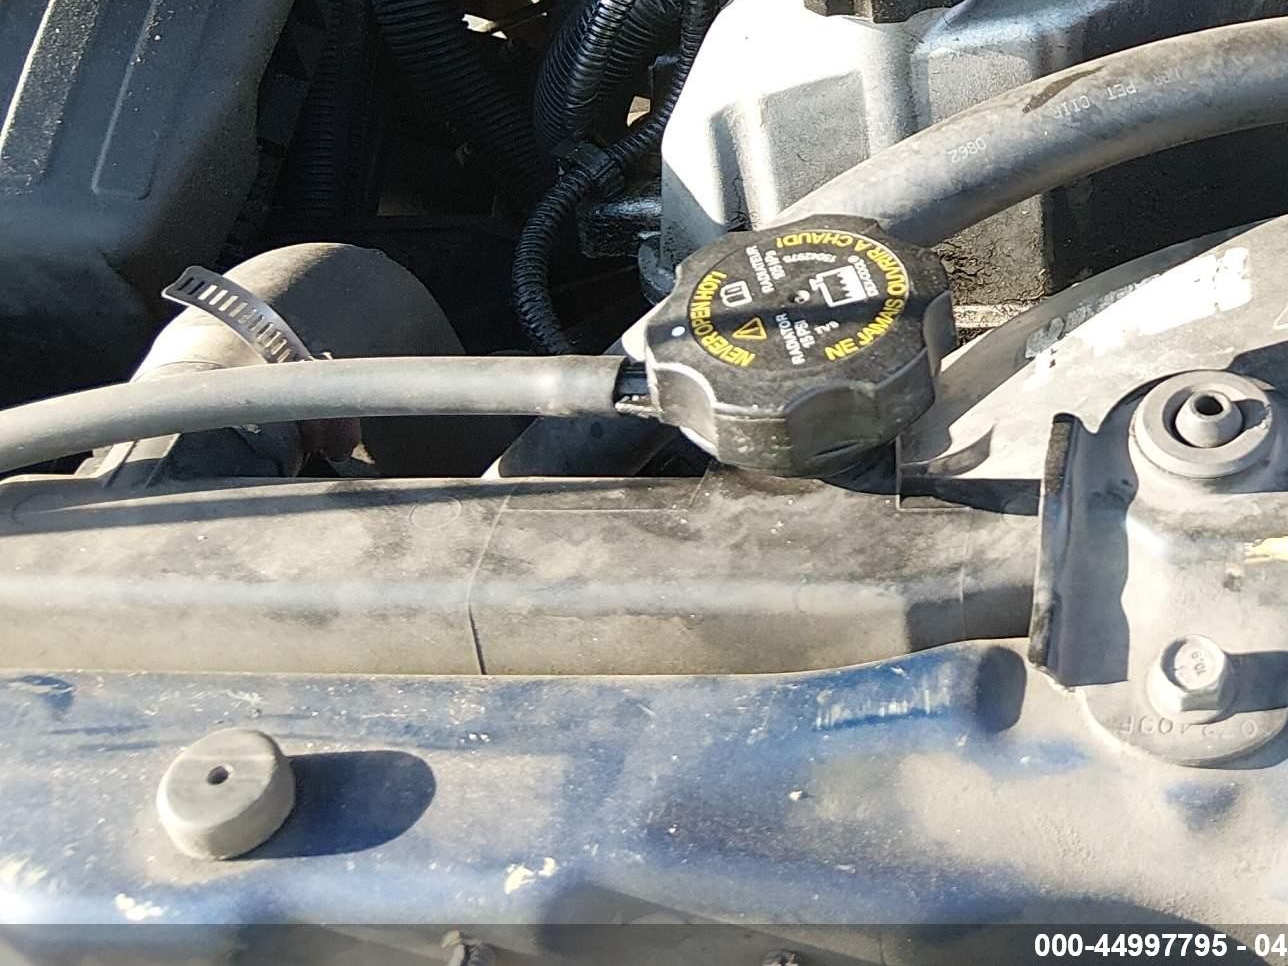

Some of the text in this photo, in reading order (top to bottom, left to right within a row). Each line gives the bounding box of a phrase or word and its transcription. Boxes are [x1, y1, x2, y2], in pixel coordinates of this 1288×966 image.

[1106, 82, 1137, 100] PET
[947, 137, 987, 164] 0862
[776, 232, 854, 248] CHAUD!
[745, 245, 775, 294] RADIATEUR
[866, 247, 907, 296] OUVRIR
[690, 270, 757, 367] NEVER OPEN HOT!
[856, 298, 905, 346] JAMAIS
[775, 312, 807, 366] RADIATOR
[799, 334, 816, 350] 15
[824, 337, 859, 361] NE
